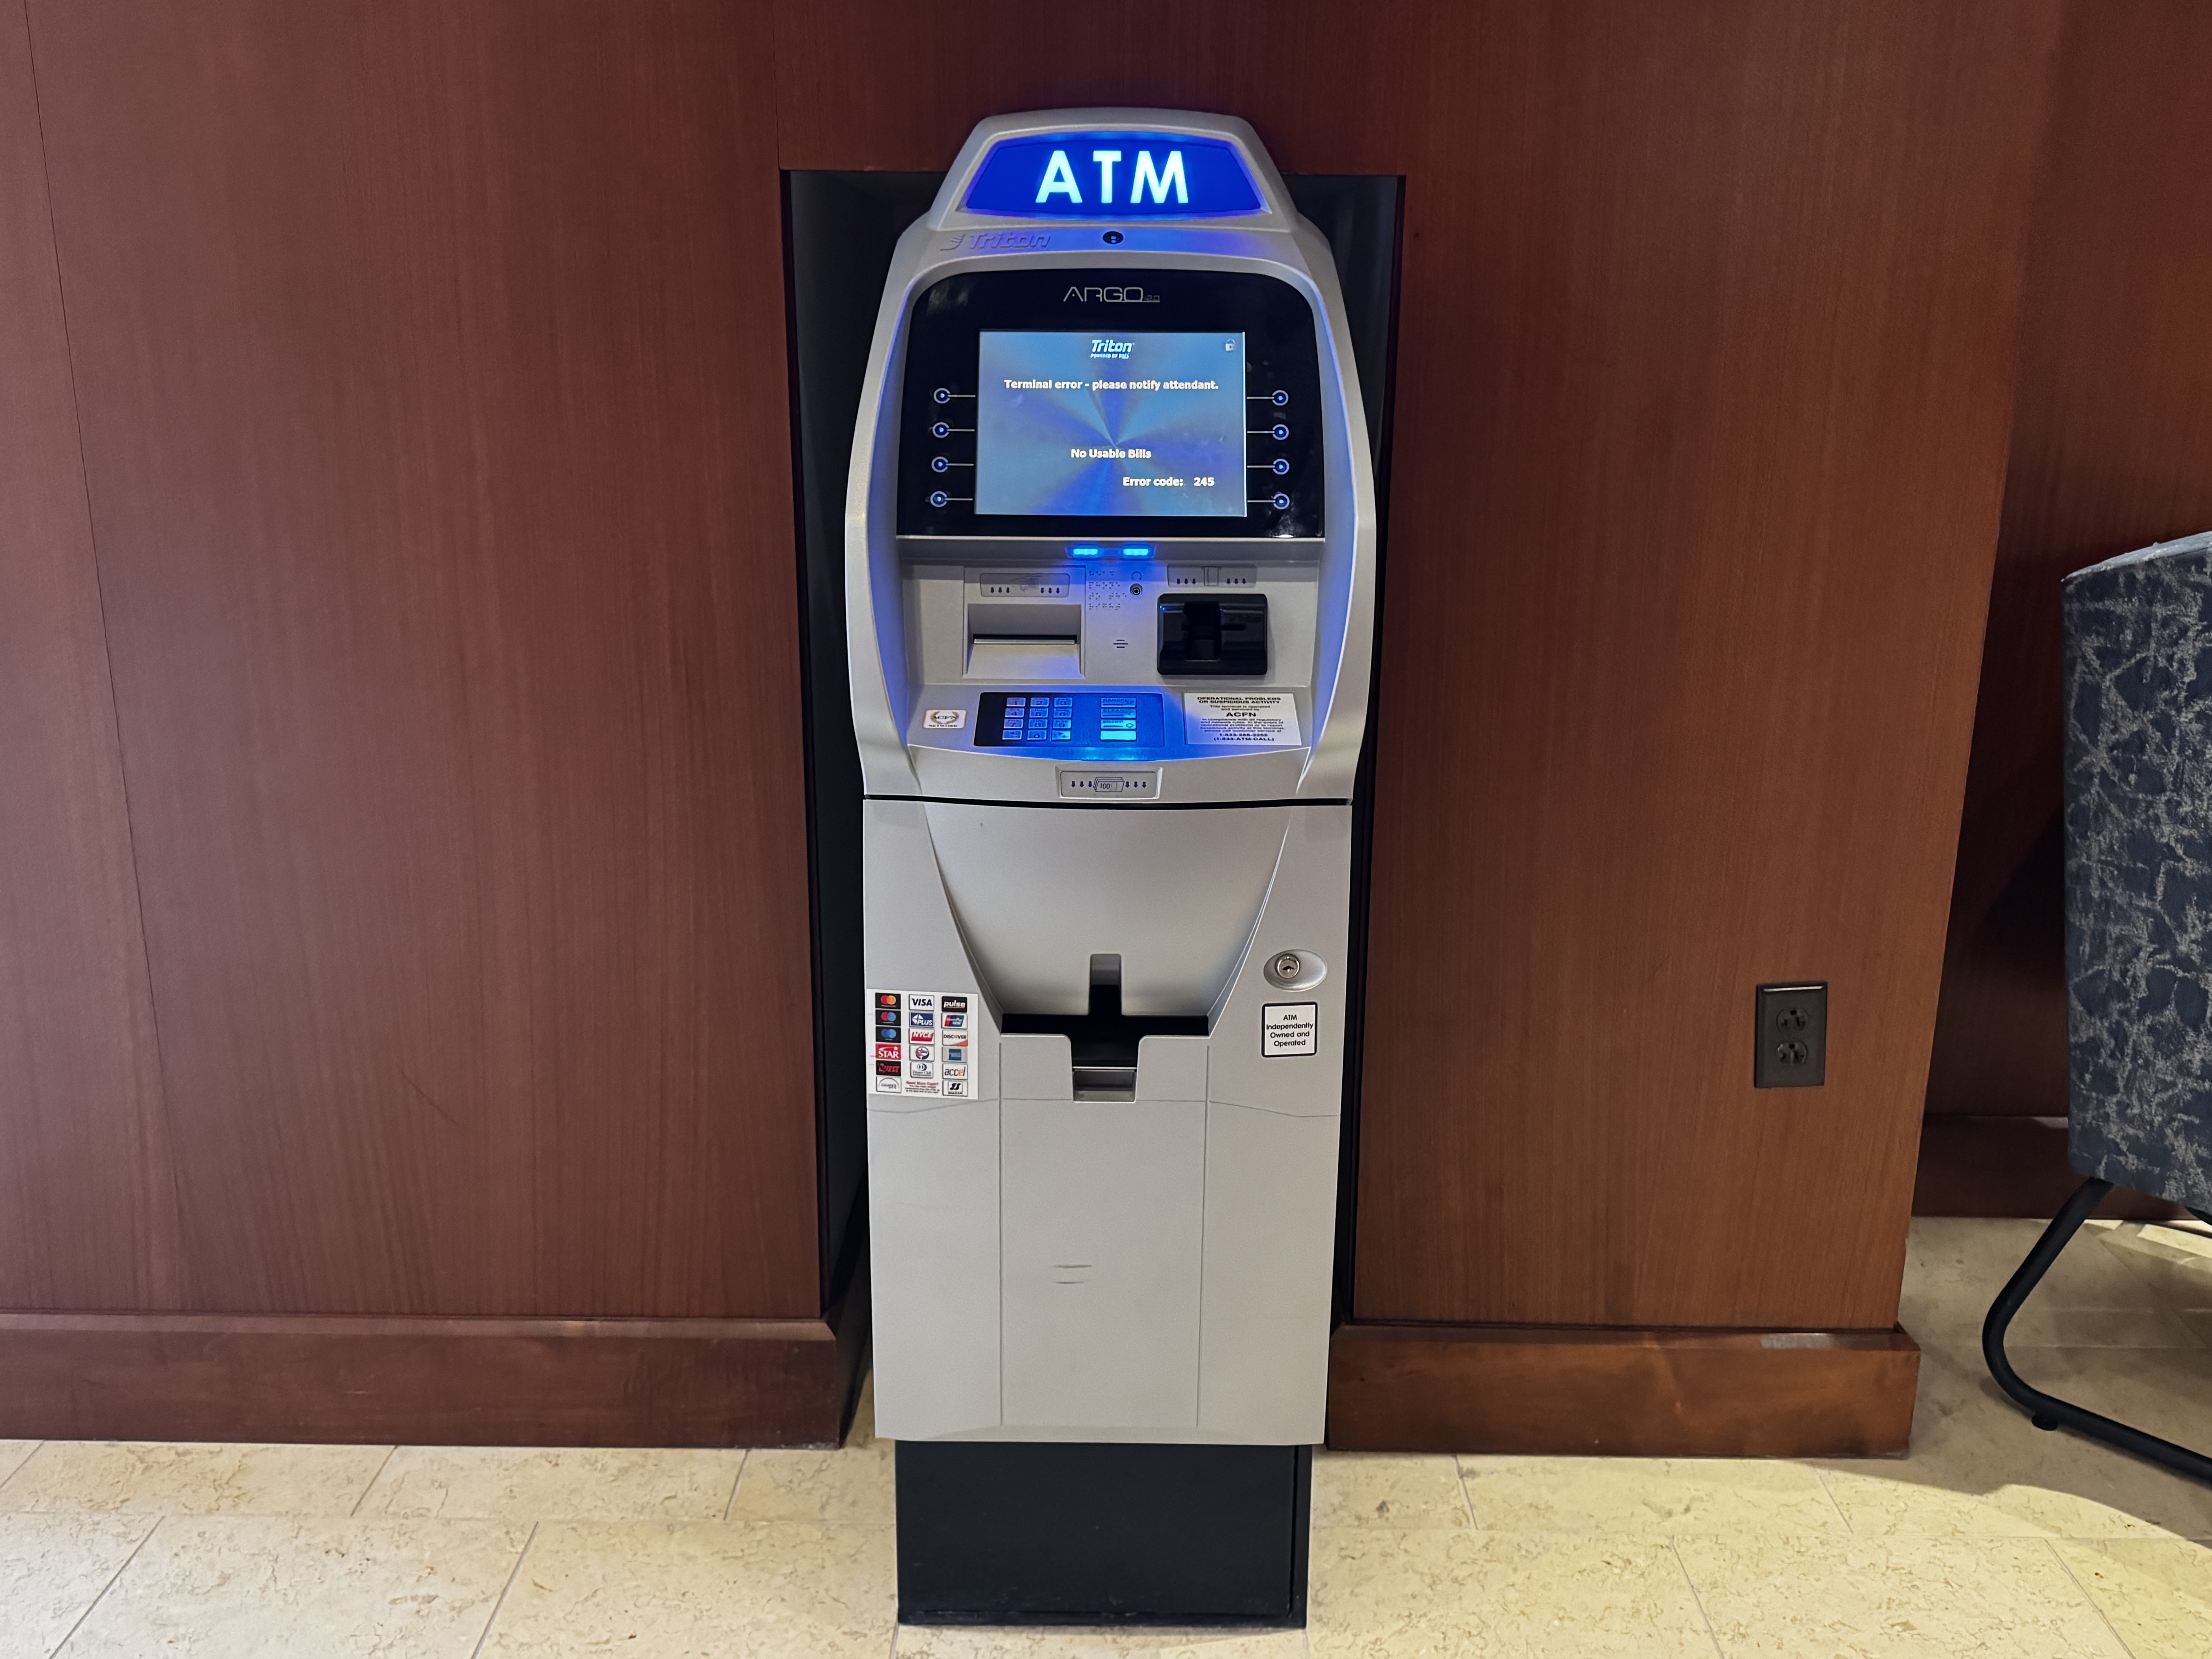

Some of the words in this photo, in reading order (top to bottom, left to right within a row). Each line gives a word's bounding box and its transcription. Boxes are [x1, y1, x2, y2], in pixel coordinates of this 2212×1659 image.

[1035, 150, 1188, 204] ATM
[969, 232, 1051, 249] Triton
[1063, 287, 1144, 302] ARGO
[1092, 339, 1132, 352] Triton
[1004, 379, 1052, 389] Terminal
[1054, 381, 1083, 389] error
[1092, 380, 1127, 391] please
[1129, 380, 1161, 391] notify
[1163, 380, 1219, 390] attendant.
[1071, 449, 1087, 458] No
[1089, 449, 1126, 458] Usable
[1128, 449, 1152, 459] Bills
[1123, 477, 1152, 486] Error
[1153, 477, 1183, 486] code:
[1193, 477, 1215, 486] 245
[912, 998, 932, 1006] VISA
[944, 1000, 966, 1008] pulse
[1266, 1022, 1314, 1030] Independently
[1274, 1039, 1306, 1048] Operated
[878, 1050, 899, 1058] STAR
[945, 1066, 966, 1077] accel
